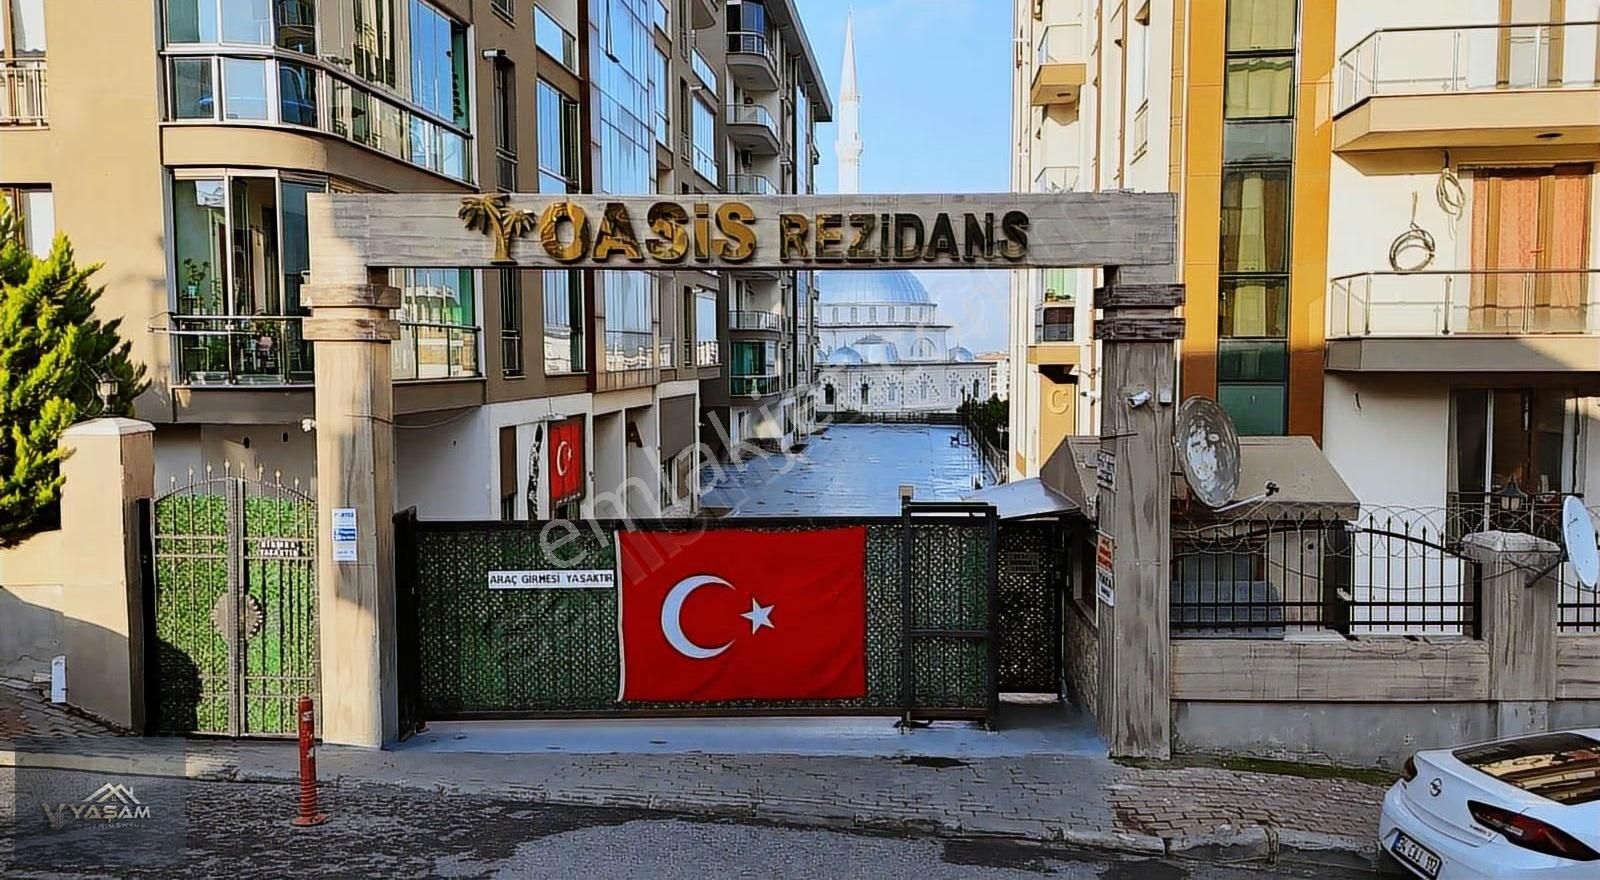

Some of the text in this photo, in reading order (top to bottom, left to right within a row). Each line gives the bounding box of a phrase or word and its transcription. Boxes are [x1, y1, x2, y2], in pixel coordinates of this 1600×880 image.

[1049, 388, 1070, 415] C
[490, 574, 517, 585] ARAÇ
[566, 572, 612, 583] YASAKTIR
